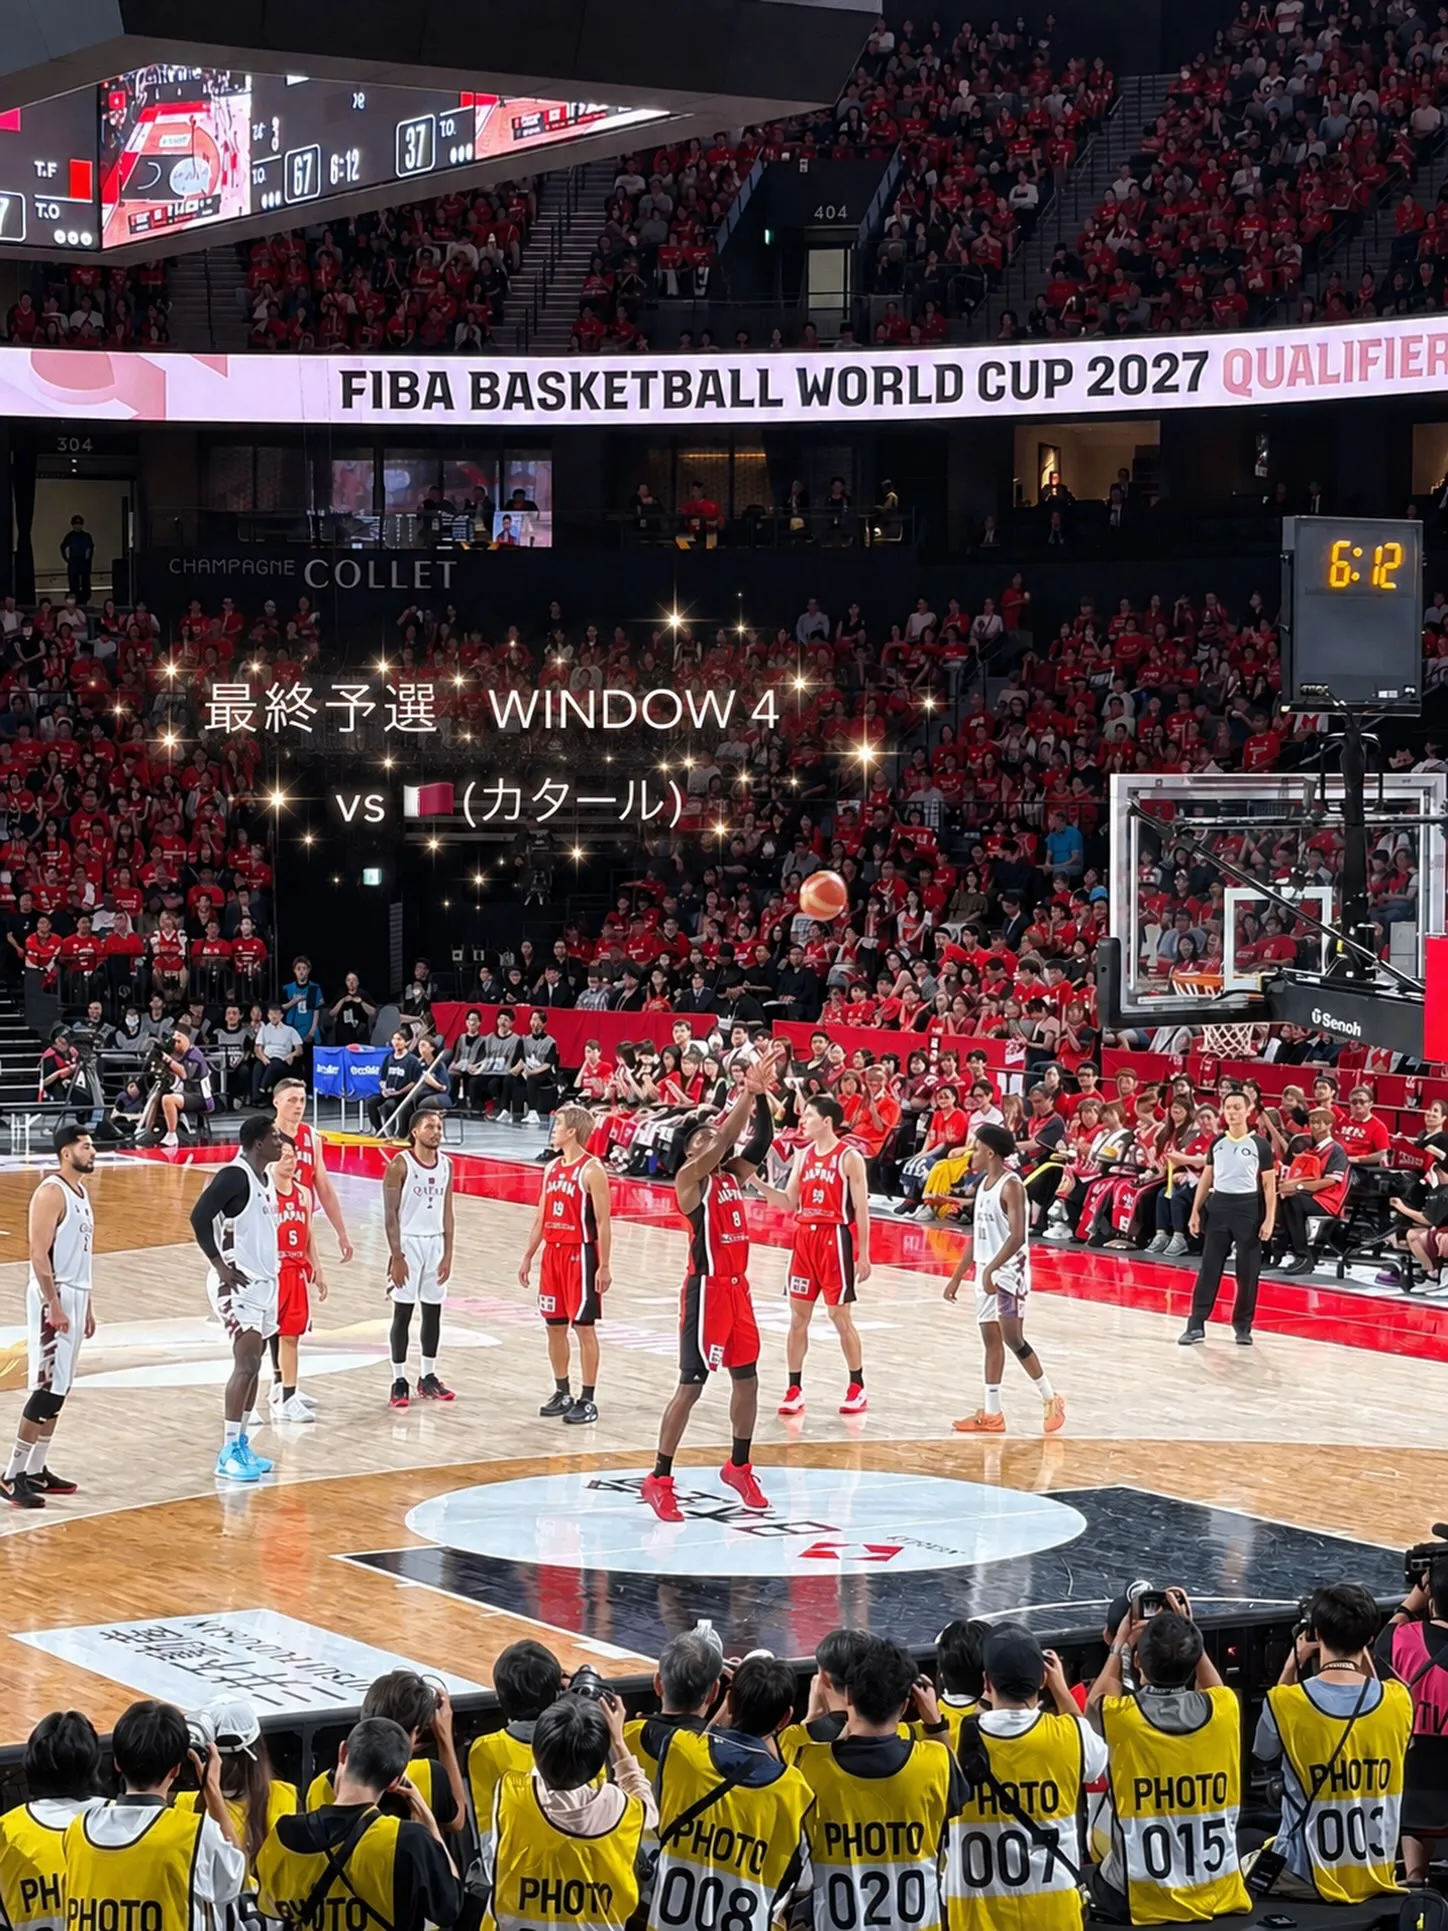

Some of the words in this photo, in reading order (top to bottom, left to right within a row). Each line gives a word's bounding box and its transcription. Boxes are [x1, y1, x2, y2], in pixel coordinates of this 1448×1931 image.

[405, 123, 427, 169] 37
[293, 152, 313, 196] 67
[330, 147, 360, 185] 6:12
[814, 205, 848, 219] 404
[339, 369, 455, 411] FIBA
[468, 367, 784, 411] BASKETBALL
[796, 362, 964, 407] WORLD
[977, 357, 1074, 401] CUP
[1087, 350, 1209, 397] 2027
[1222, 332, 1448, 398] QUALIFIER
[57, 437, 94, 453] 304
[168, 558, 296, 576] CHAMPAGNE
[303, 558, 458, 590] COLLET
[1328, 540, 1403, 590] 6:12
[1322, 1012, 1362, 1038] Senoh
[732, 1210, 743, 1228] 8
[1133, 1771, 1228, 1811] PHOTO
[1309, 1757, 1392, 1793] PHOTO
[969, 1780, 1059, 1815] HOTO
[824, 1821, 925, 1857] PHOTO
[1142, 1817, 1227, 1880] 015
[67, 1897, 163, 1931] PHOTO
[519, 1876, 613, 1916] PHOTO
[659, 1866, 758, 1931] 008
[828, 1869, 926, 1930] 020
